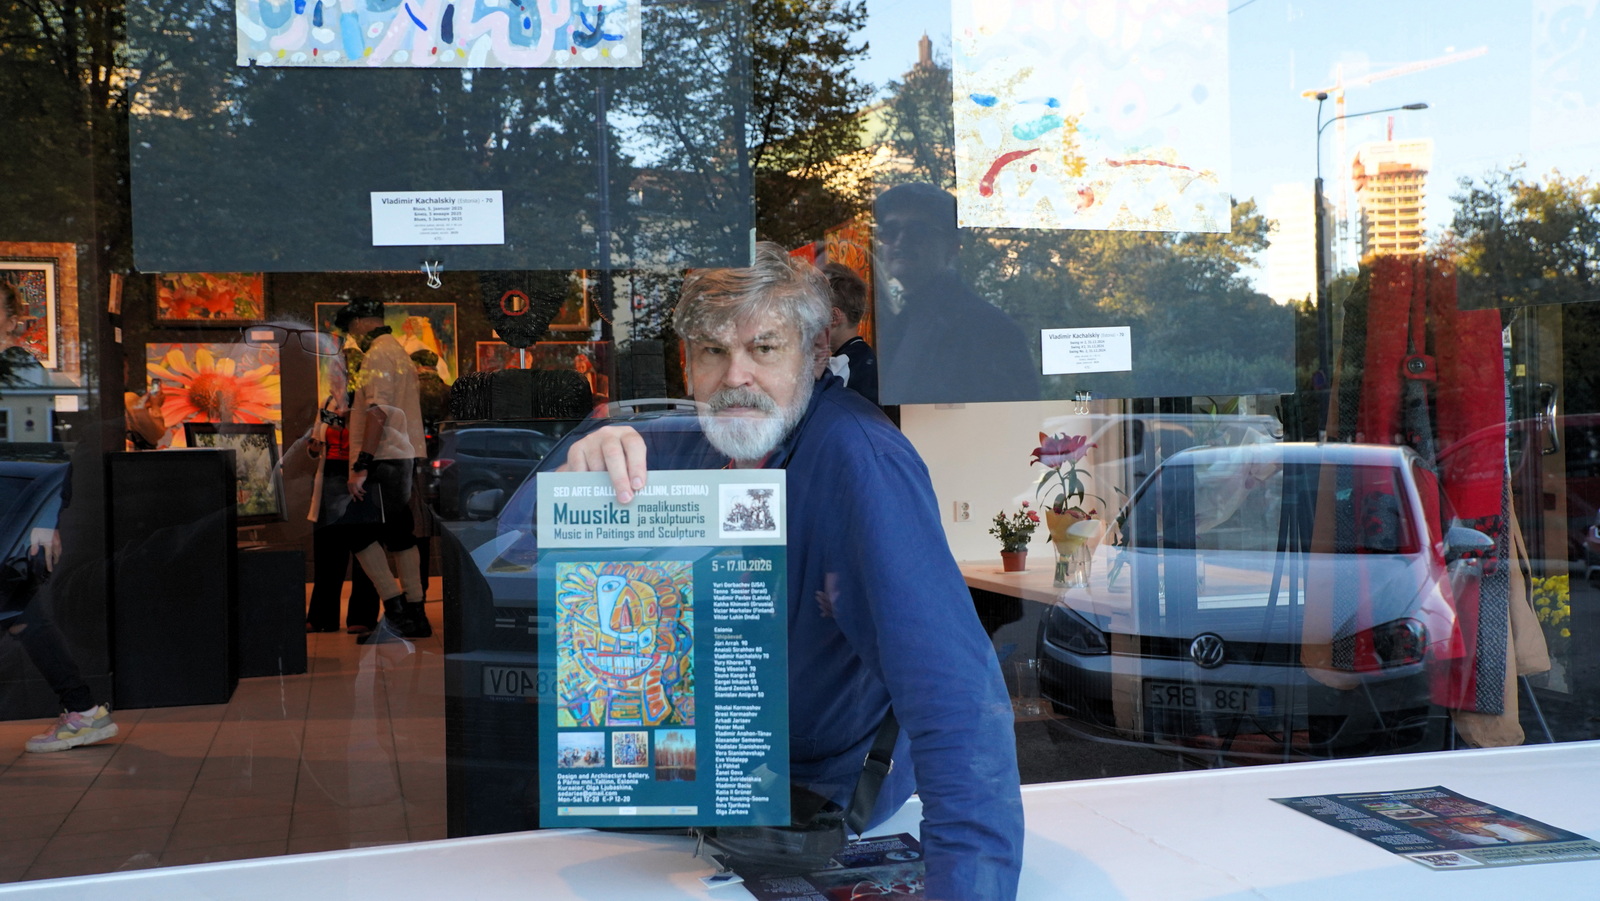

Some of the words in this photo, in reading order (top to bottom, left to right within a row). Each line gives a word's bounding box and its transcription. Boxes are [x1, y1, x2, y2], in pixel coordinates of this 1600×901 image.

[554, 486, 570, 497] SED
[572, 486, 592, 497] ARTE
[671, 484, 709, 496] ESTONIA)
[554, 502, 630, 525] Muusika
[638, 501, 700, 513] maalikunstis
[637, 513, 646, 526] ja
[650, 513, 705, 526] skulptuuris
[554, 529, 582, 540] Music
[584, 528, 593, 539] in
[596, 528, 635, 541] Paitings
[638, 527, 655, 538] and
[658, 526, 706, 541] Sculpture
[712, 560, 718, 571] 5
[727, 560, 772, 571] 17.10.2026
